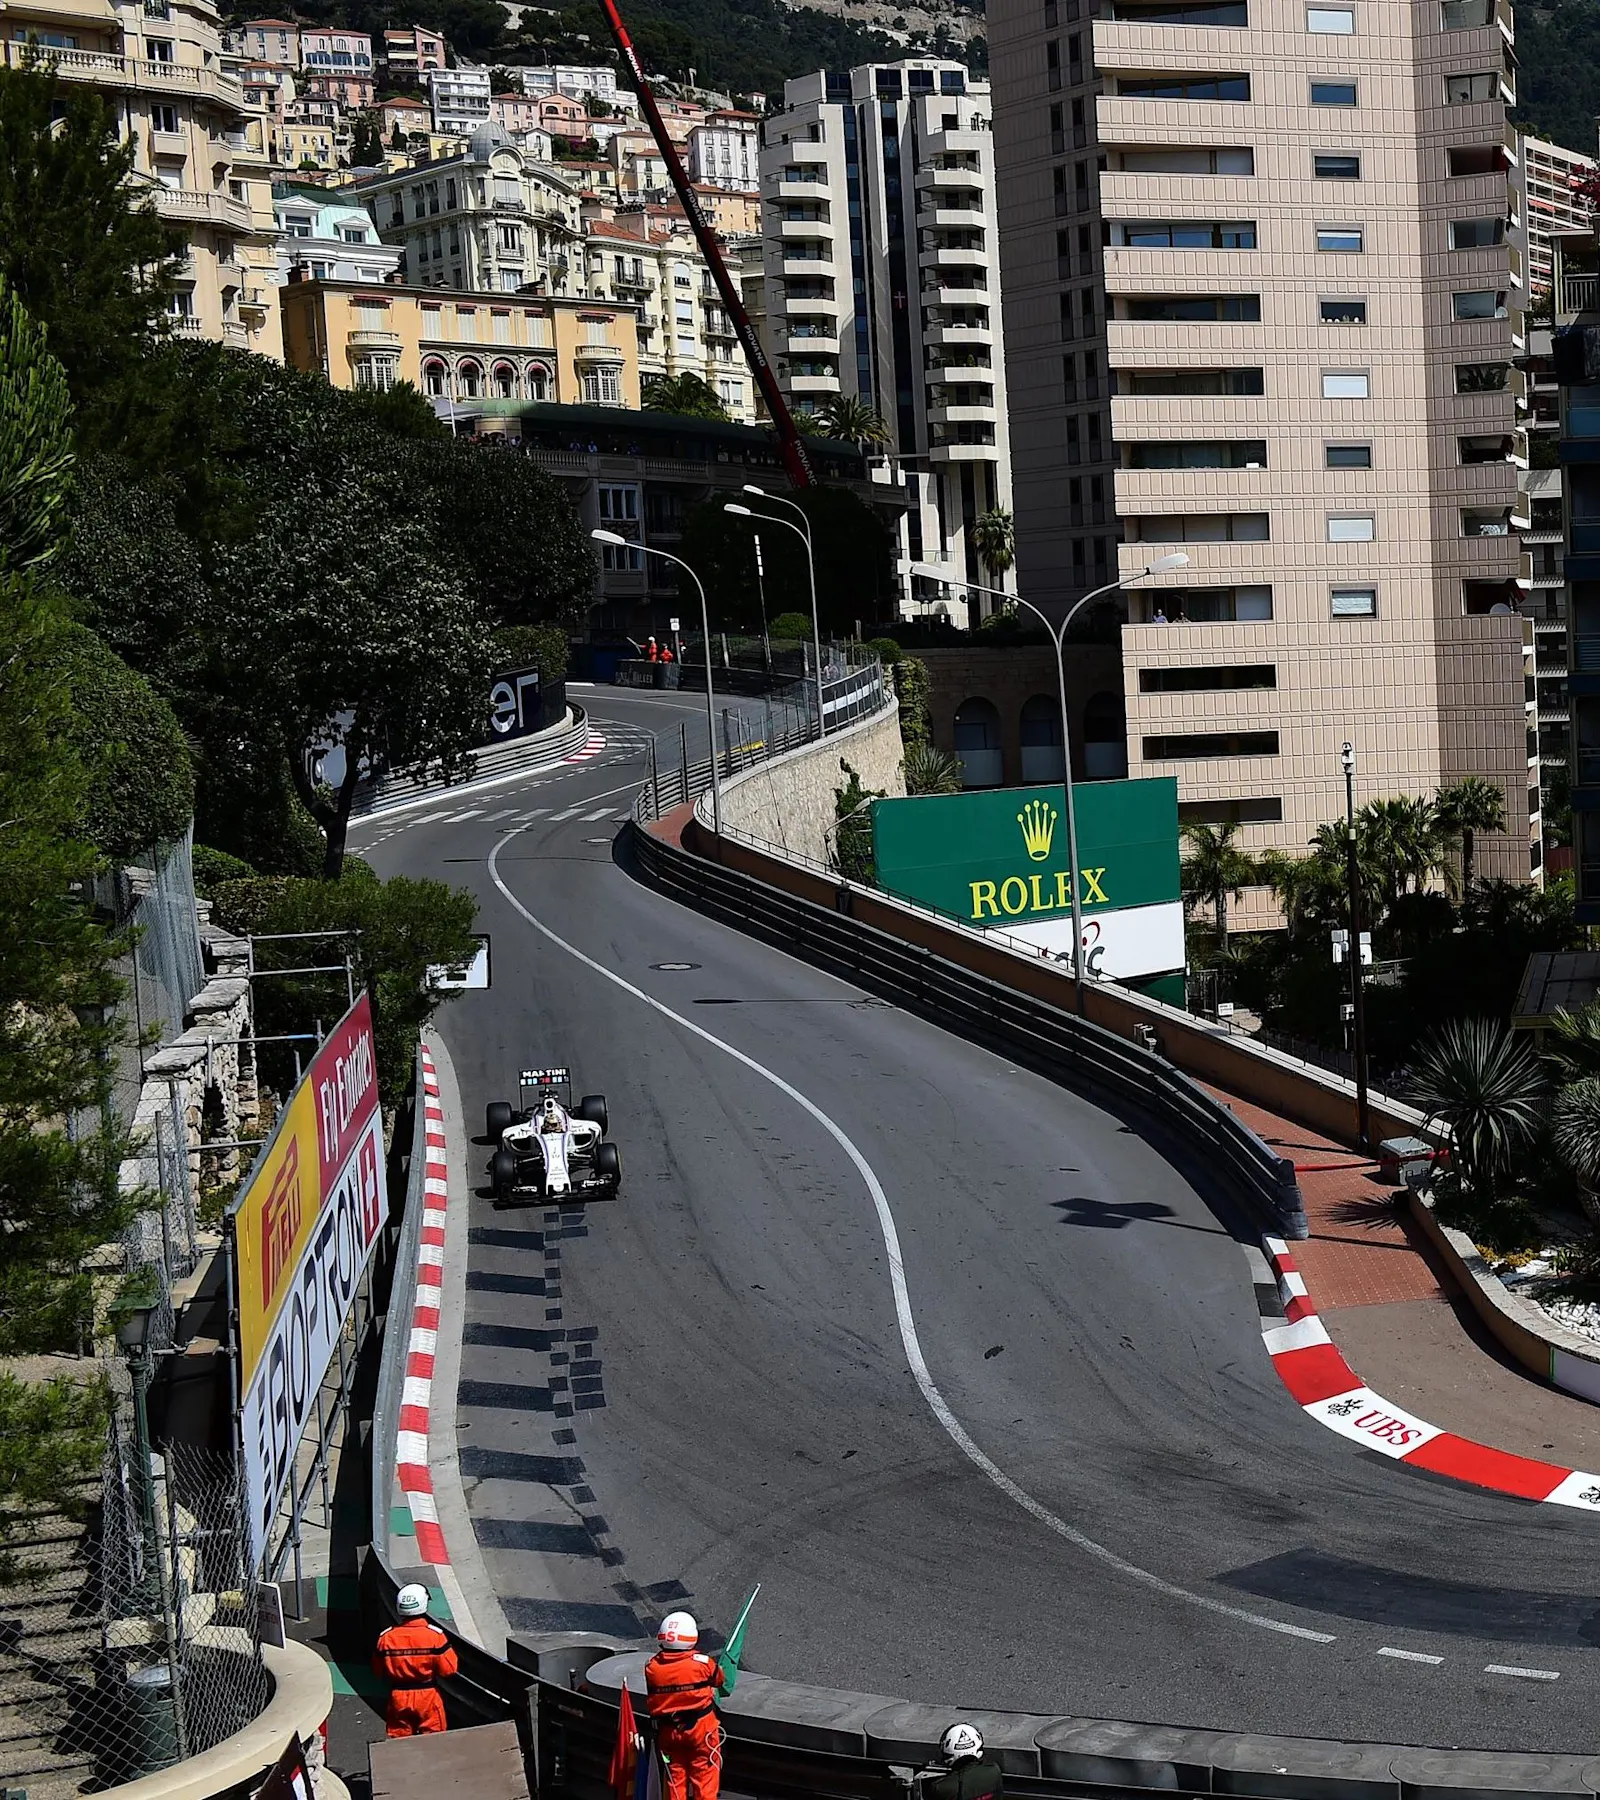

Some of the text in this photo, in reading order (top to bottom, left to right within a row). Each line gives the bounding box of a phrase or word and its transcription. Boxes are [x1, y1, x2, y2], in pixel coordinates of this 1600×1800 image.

[686, 188, 706, 228] PIOVANO
[744, 325, 766, 367] PIOVANO
[968, 867, 1110, 919] ROLEX
[320, 1028, 372, 1163] Fly Emirates
[261, 1134, 301, 1314] PIRELLI
[1353, 1410, 1422, 1445] UBS
